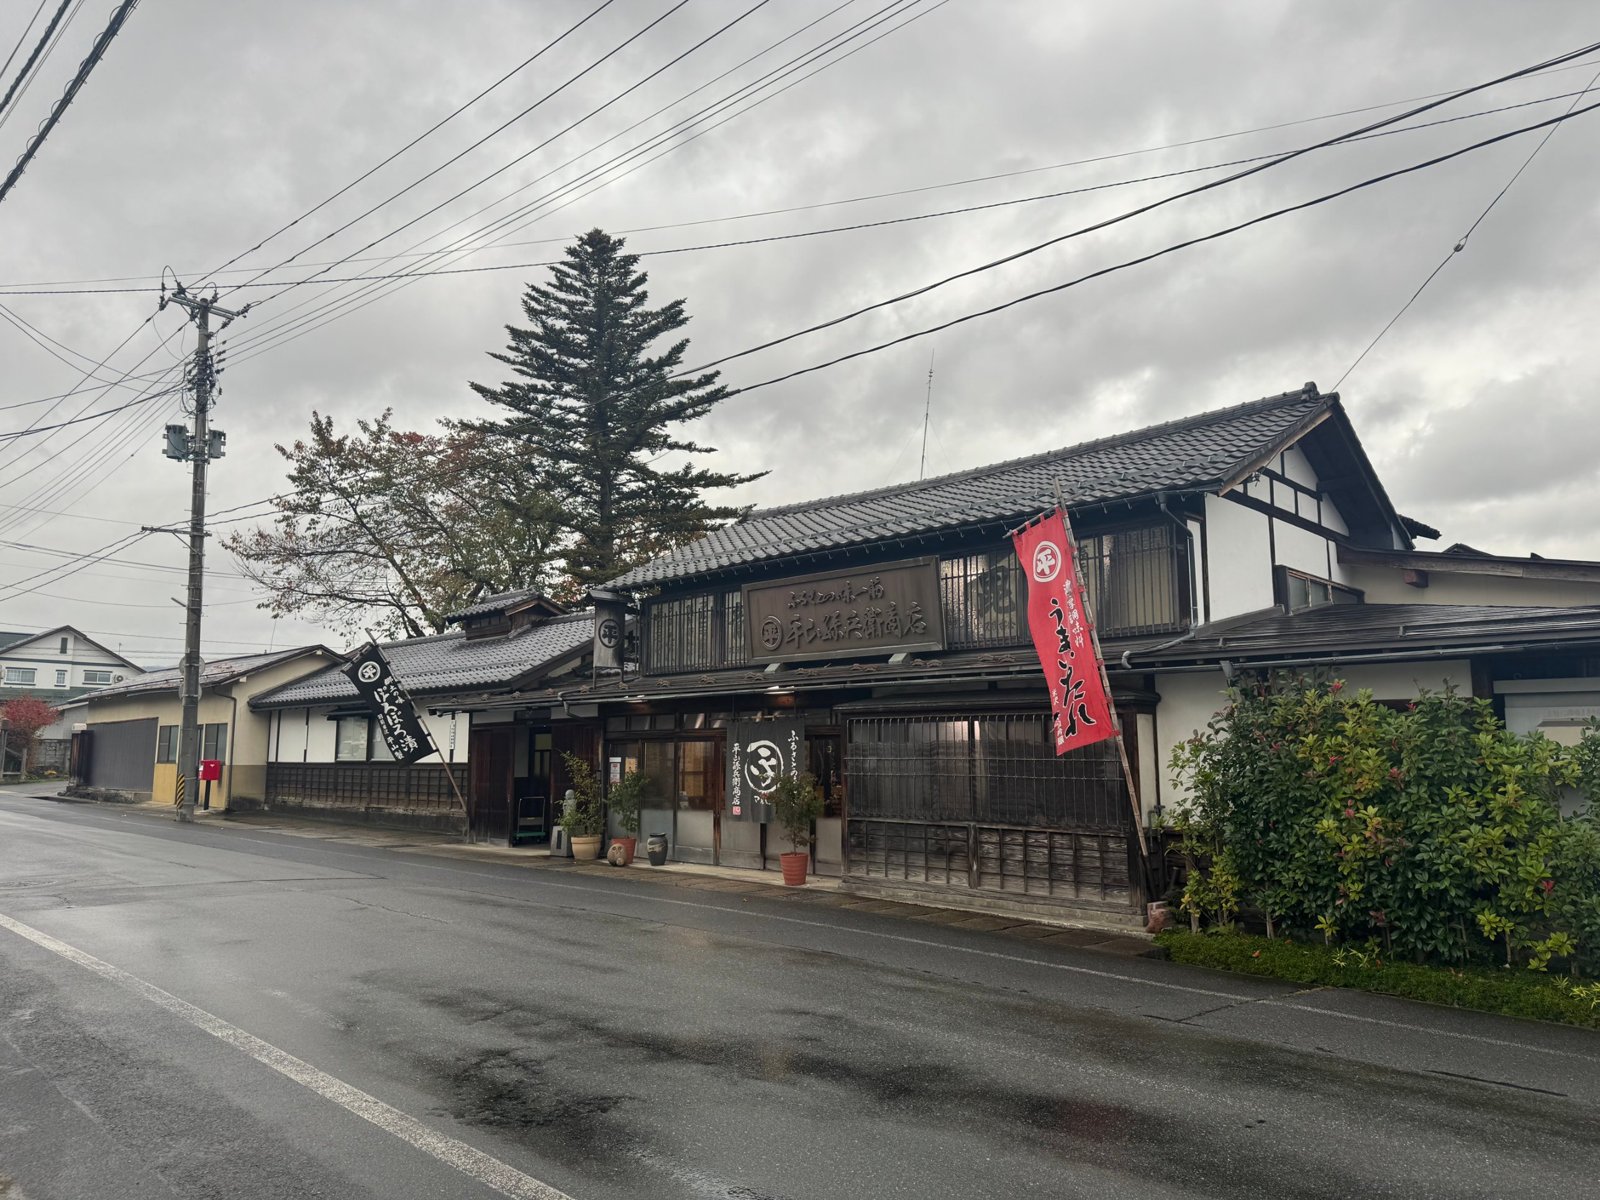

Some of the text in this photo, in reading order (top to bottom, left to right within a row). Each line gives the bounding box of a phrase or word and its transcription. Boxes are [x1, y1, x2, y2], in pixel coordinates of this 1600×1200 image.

[1049, 598, 1096, 738] うまいたれ
